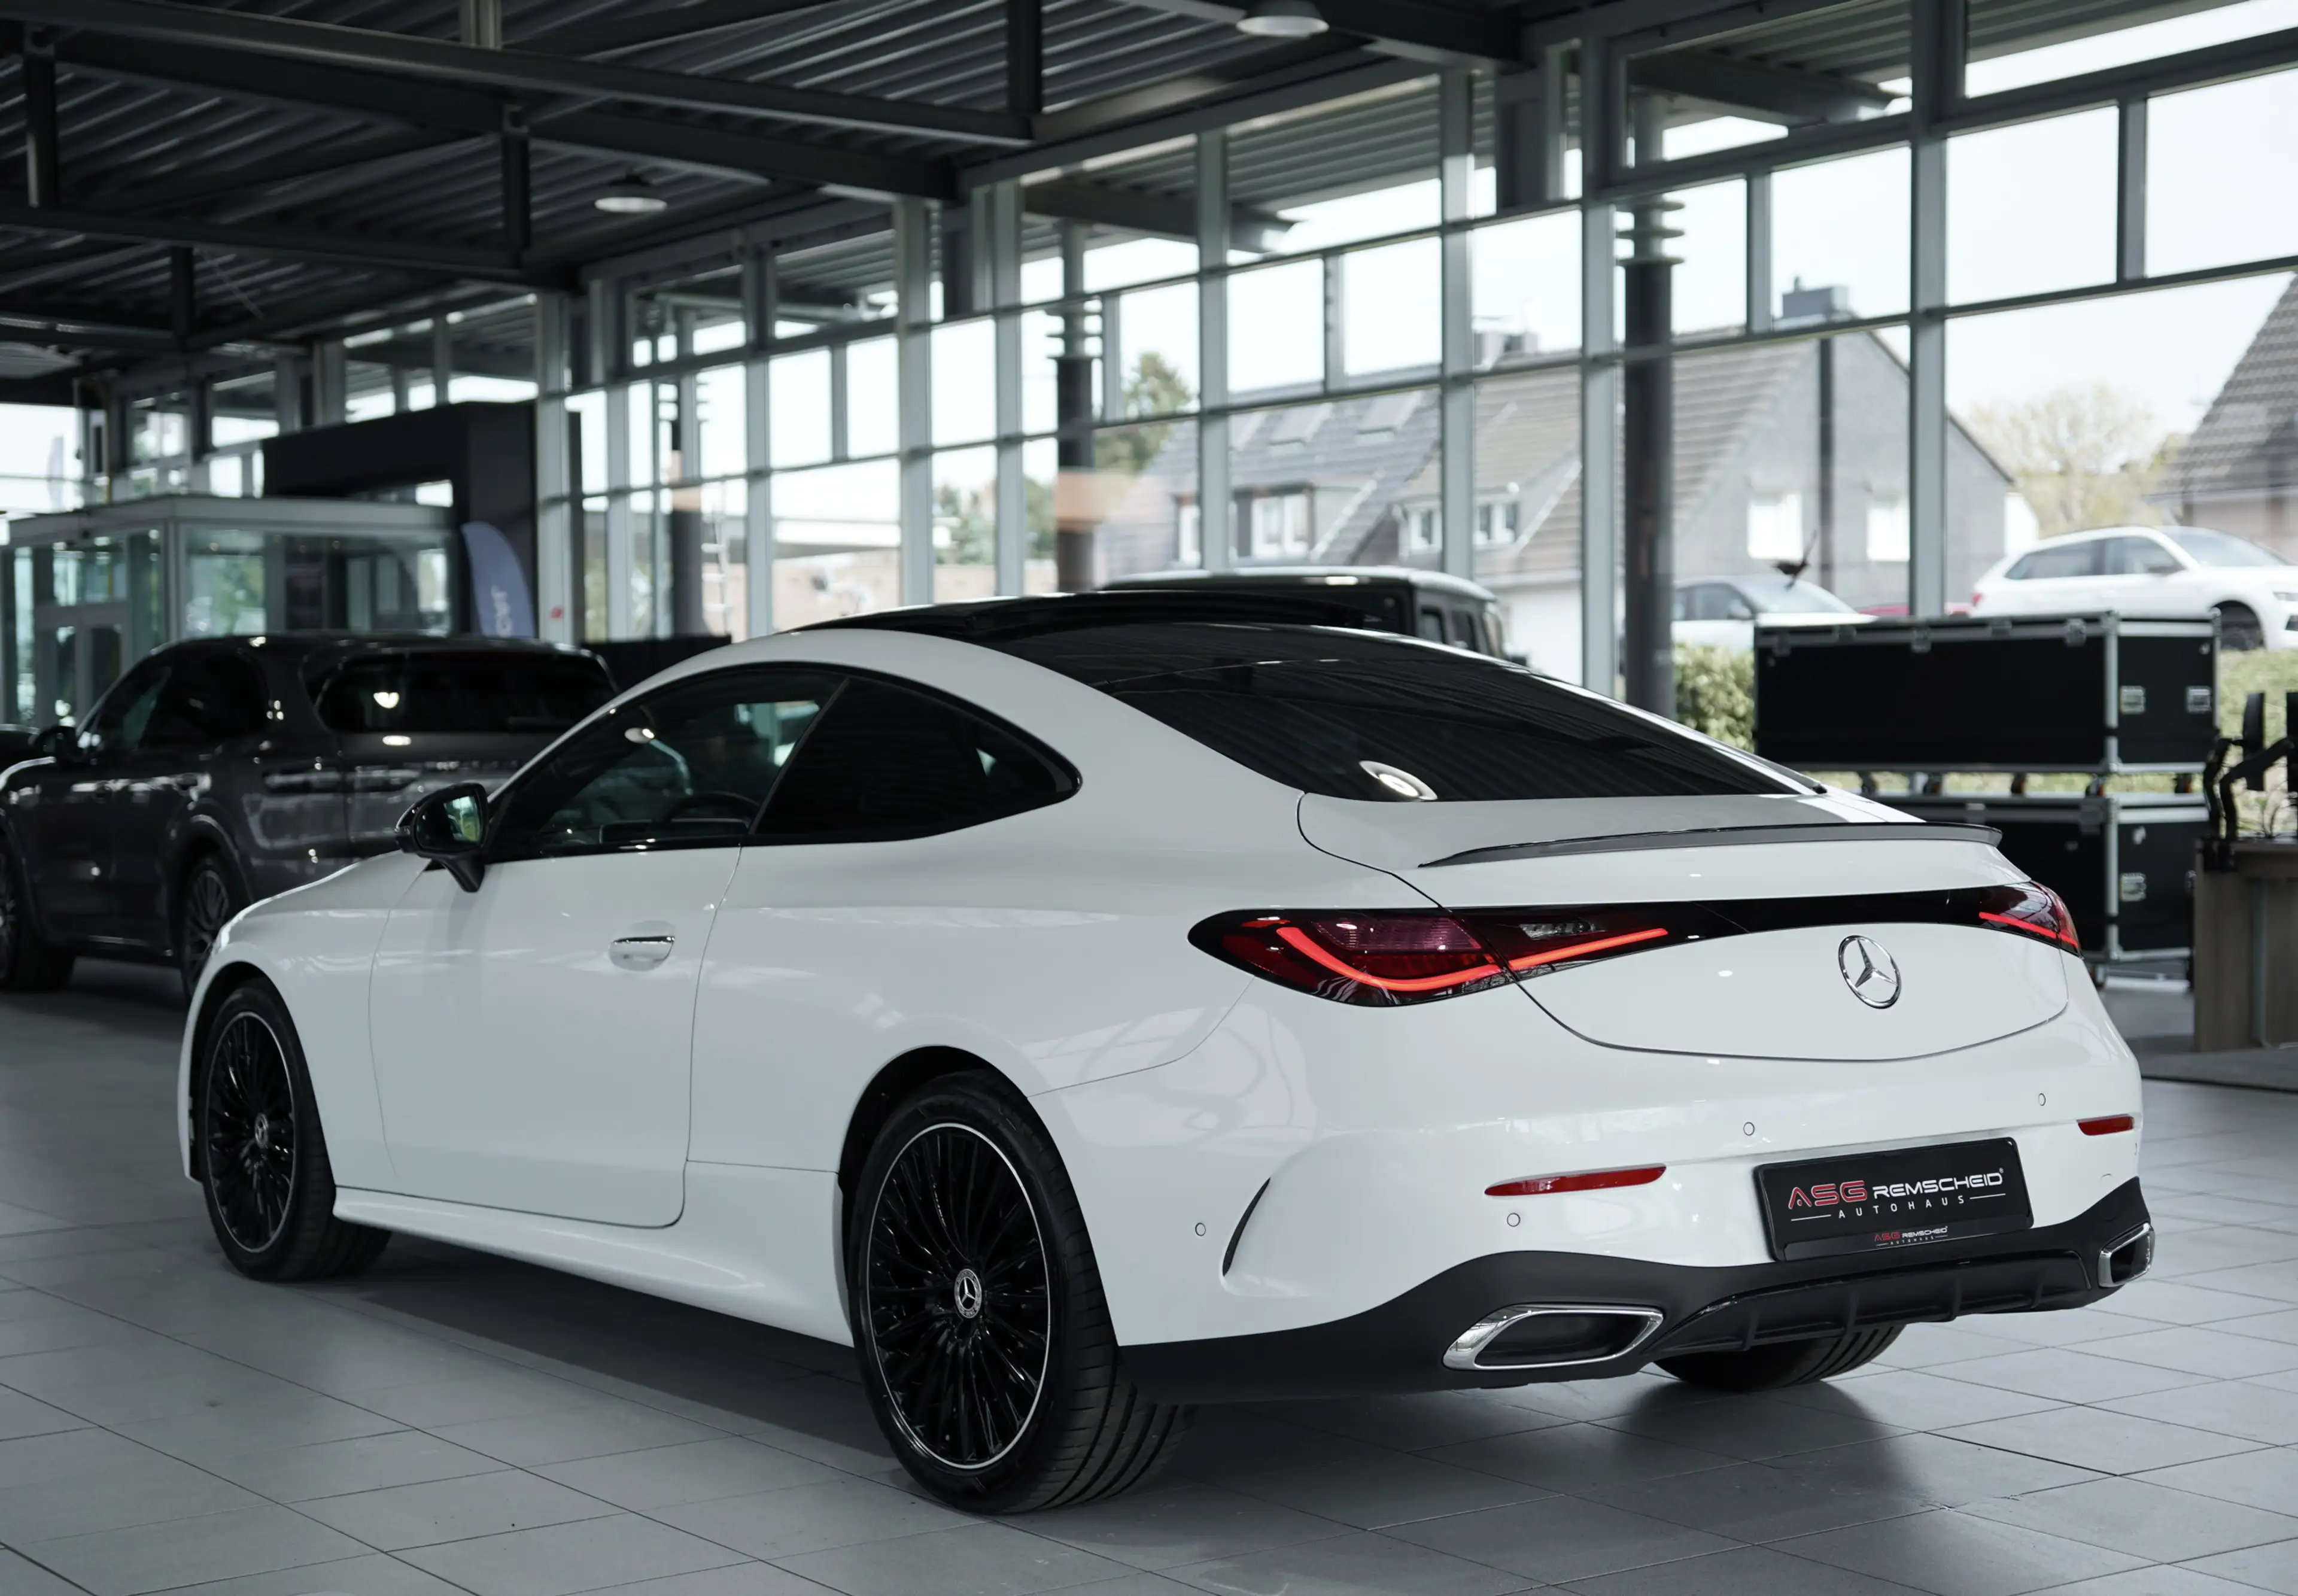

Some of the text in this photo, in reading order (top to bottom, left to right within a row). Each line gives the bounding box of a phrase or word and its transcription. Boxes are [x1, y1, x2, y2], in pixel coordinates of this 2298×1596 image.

[1788, 1180, 1867, 1209] ASG
[1838, 1195, 1964, 1218] AUTOHAUS
[1874, 1232, 1901, 1242] ASG
